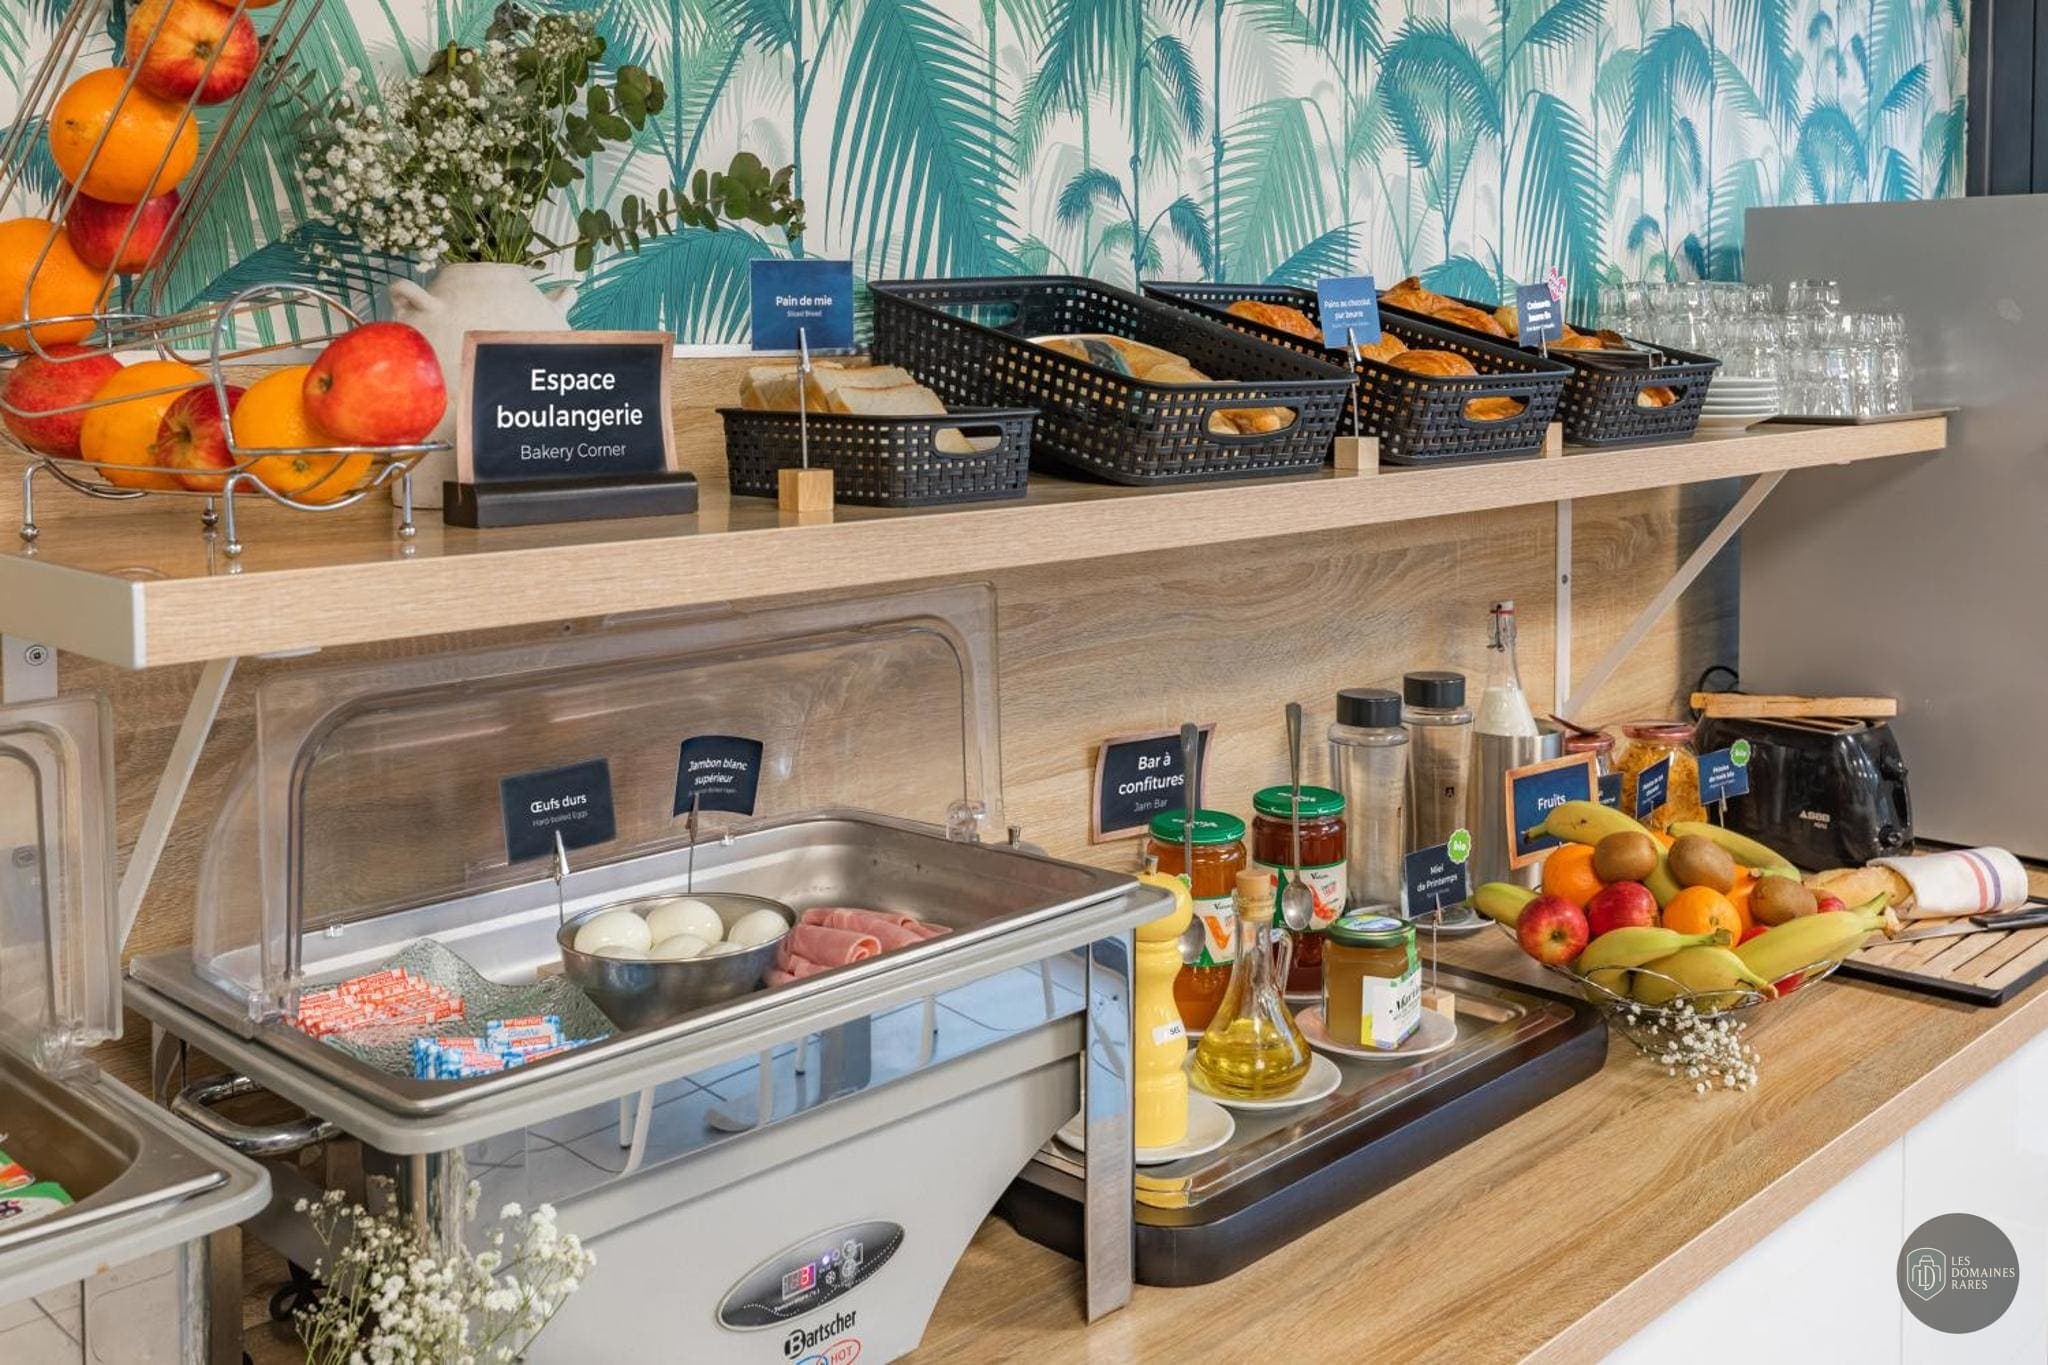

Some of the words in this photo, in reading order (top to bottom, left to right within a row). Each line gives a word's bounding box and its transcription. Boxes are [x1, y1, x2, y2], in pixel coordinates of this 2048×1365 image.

[775, 294, 798, 307] Pain
[799, 295, 813, 307] de
[814, 294, 833, 307] mie
[531, 369, 616, 396] Espace
[497, 403, 643, 431] boulangerie
[520, 444, 574, 462] Bakery
[577, 443, 626, 459] Corner
[687, 757, 722, 772] Jambon
[723, 757, 748, 771] blanc
[1138, 755, 1161, 770] Bar
[1163, 752, 1171, 767] à
[1118, 773, 1185, 795] confitures
[530, 797, 560, 813] Œufs
[562, 794, 587, 808] durs
[1134, 801, 1152, 812] Jam
[1154, 799, 1168, 809] Bar
[1537, 793, 1566, 810] Fruits
[784, 1310, 857, 1360] Bartscher
